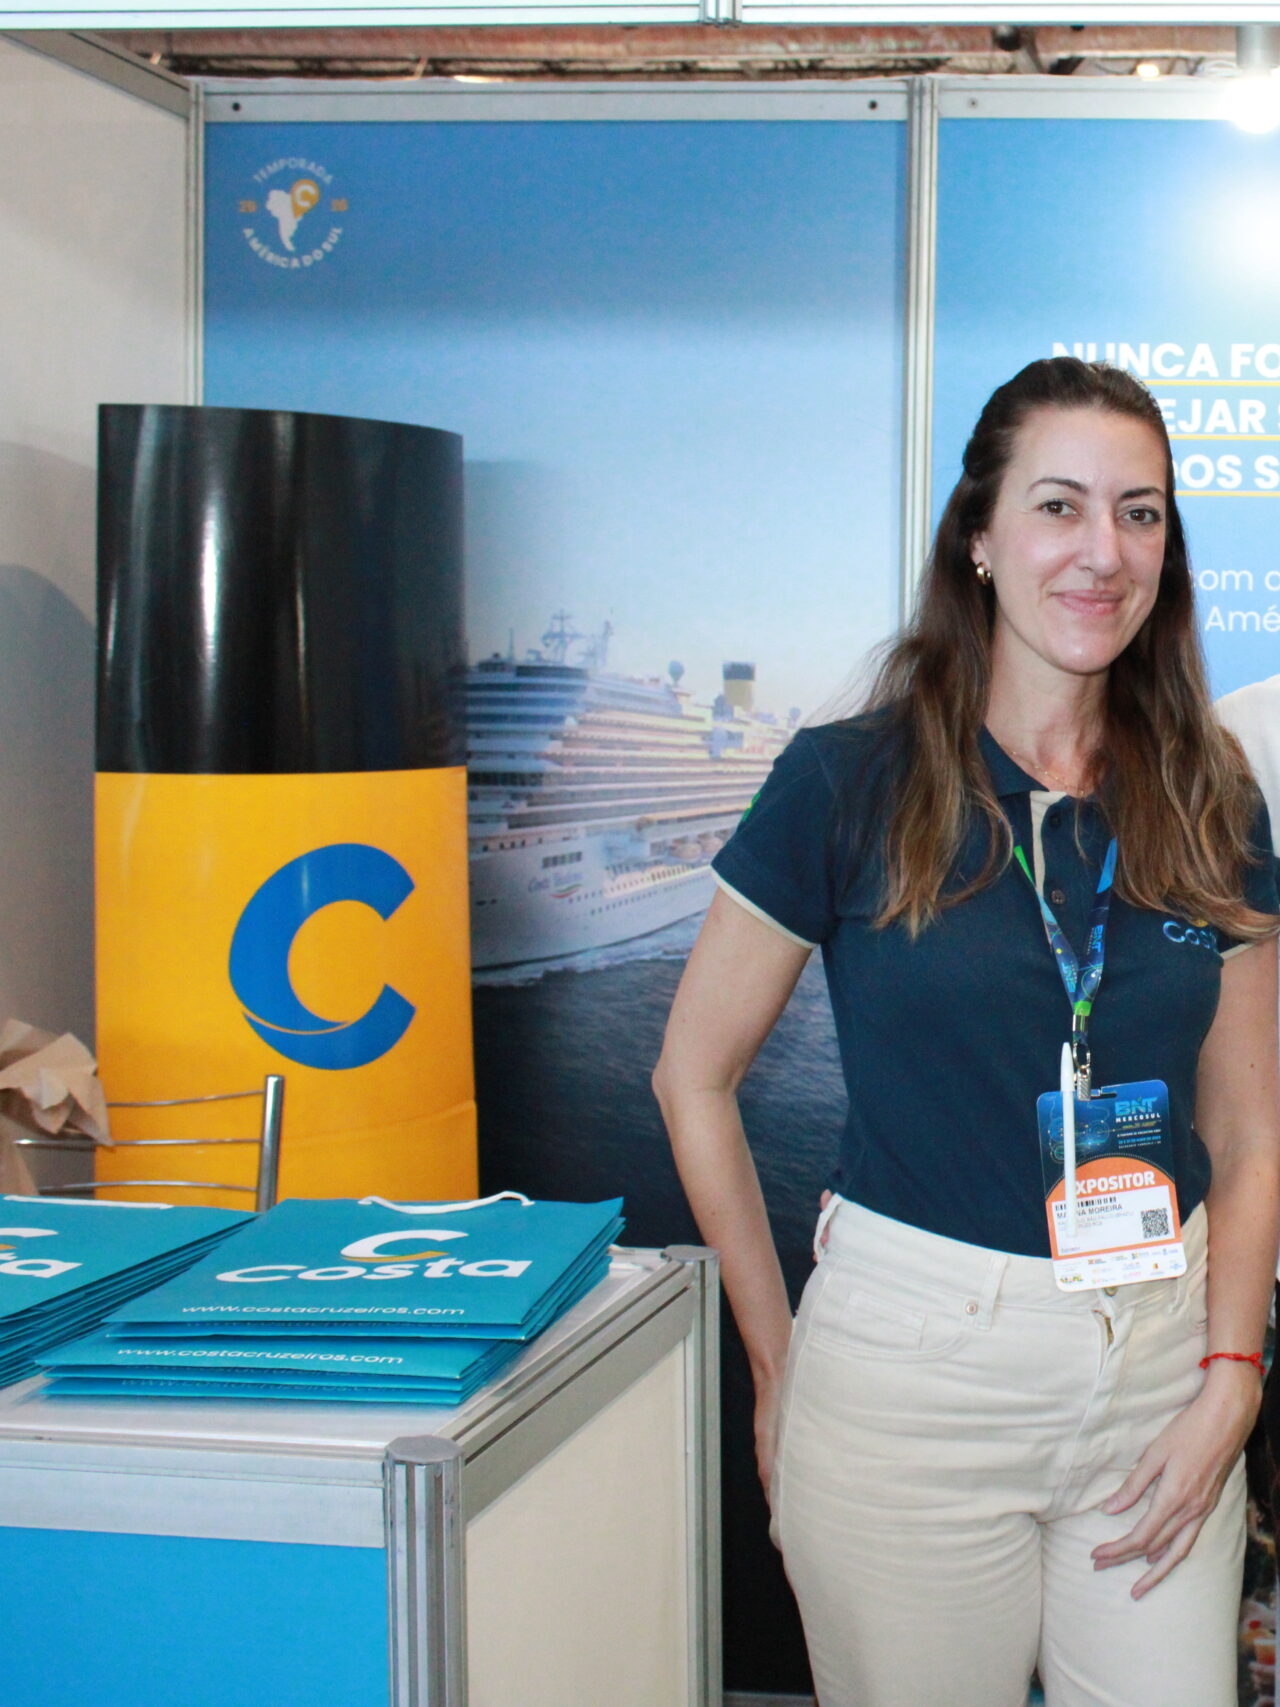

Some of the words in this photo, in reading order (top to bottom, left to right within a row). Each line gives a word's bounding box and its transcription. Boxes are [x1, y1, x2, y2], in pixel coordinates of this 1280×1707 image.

[302, 250, 324, 267] DO
[1173, 454, 1242, 489] OS
[1193, 568, 1254, 592] om
[1115, 1097, 1158, 1116] BNT
[1115, 1113, 1161, 1123] MERCOSUL
[1076, 1171, 1156, 1195] XPOSITOR
[1088, 1203, 1123, 1215] MOREIRA
[215, 1257, 533, 1283] Costa
[182, 1305, 465, 1316] www.costacruzeiros.com
[117, 1348, 404, 1364] www.costacruzeiros.com
